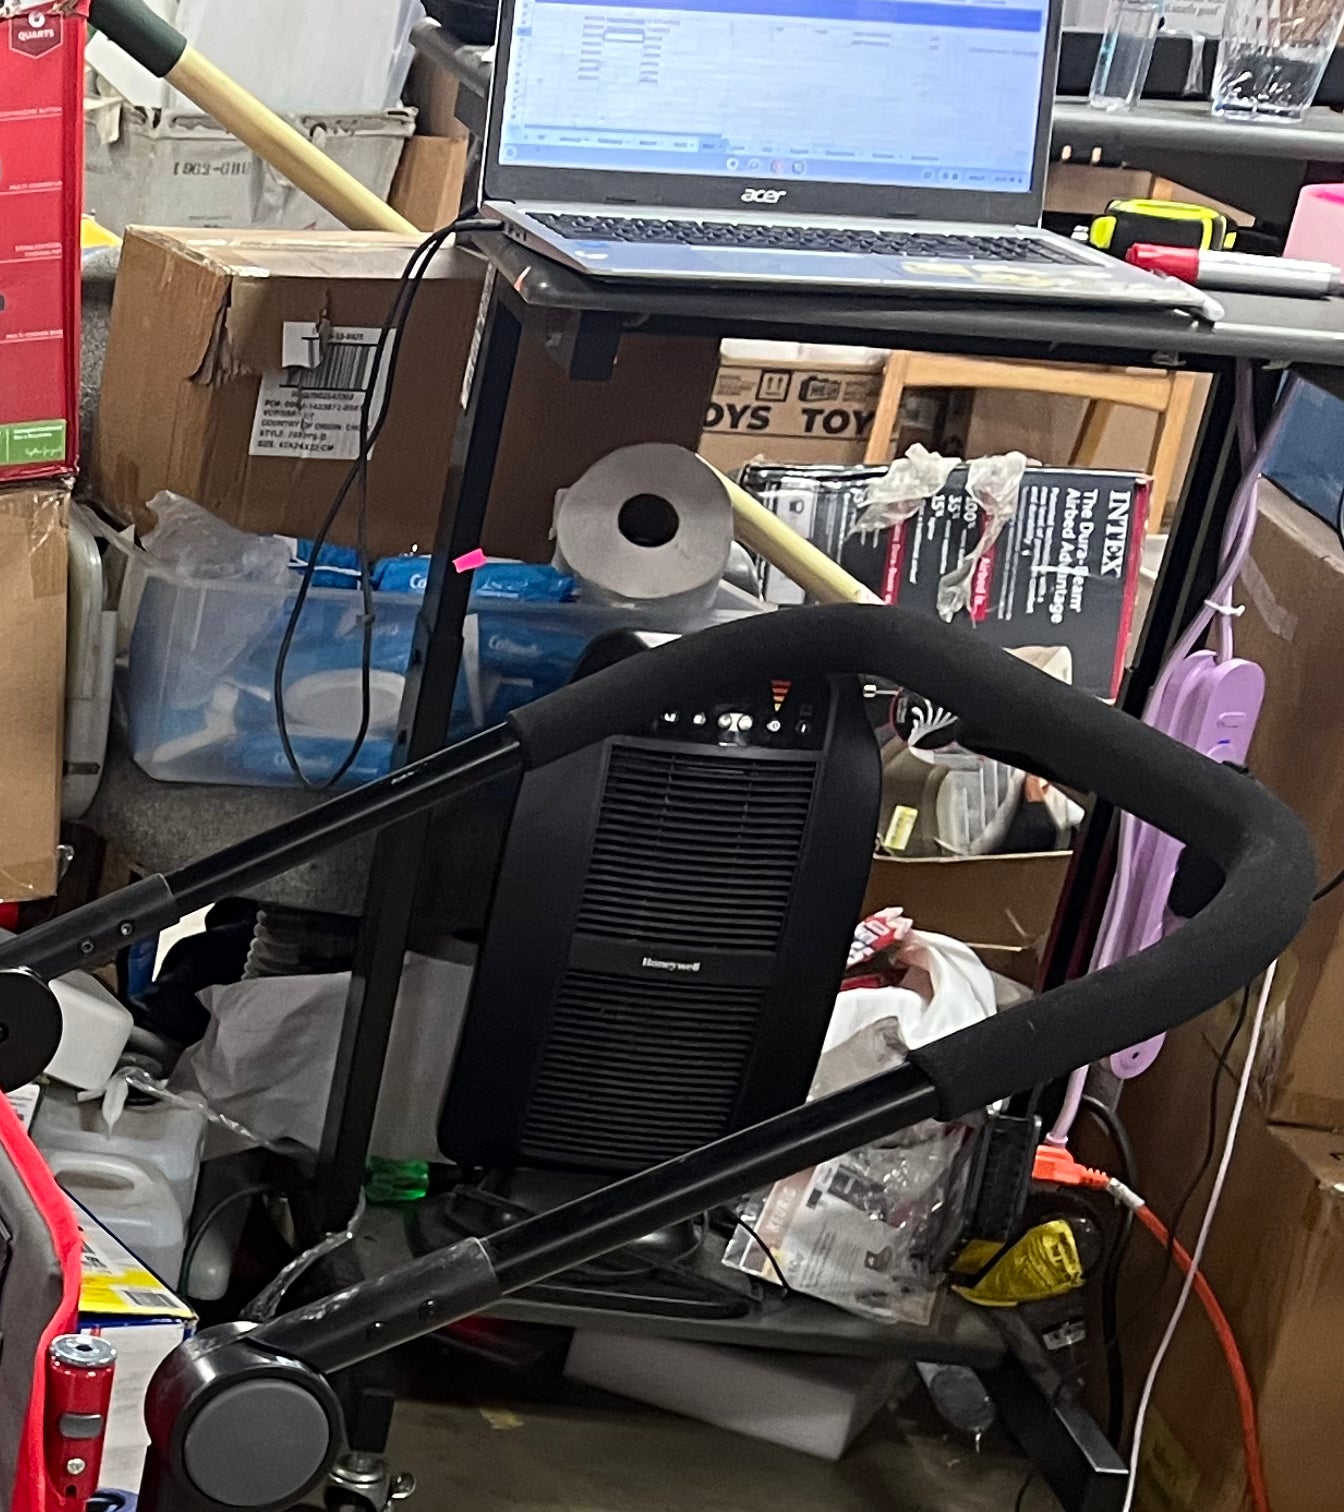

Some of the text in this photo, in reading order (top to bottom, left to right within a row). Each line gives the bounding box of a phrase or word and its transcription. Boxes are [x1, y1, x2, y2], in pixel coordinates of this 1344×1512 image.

[741, 187, 787, 205] acer
[703, 402, 876, 435] OYS TOY
[1062, 488, 1081, 539] Airbed
[1081, 488, 1099, 519] The
[1101, 490, 1132, 578] INTEX
[642, 957, 701, 972] Honeywell
